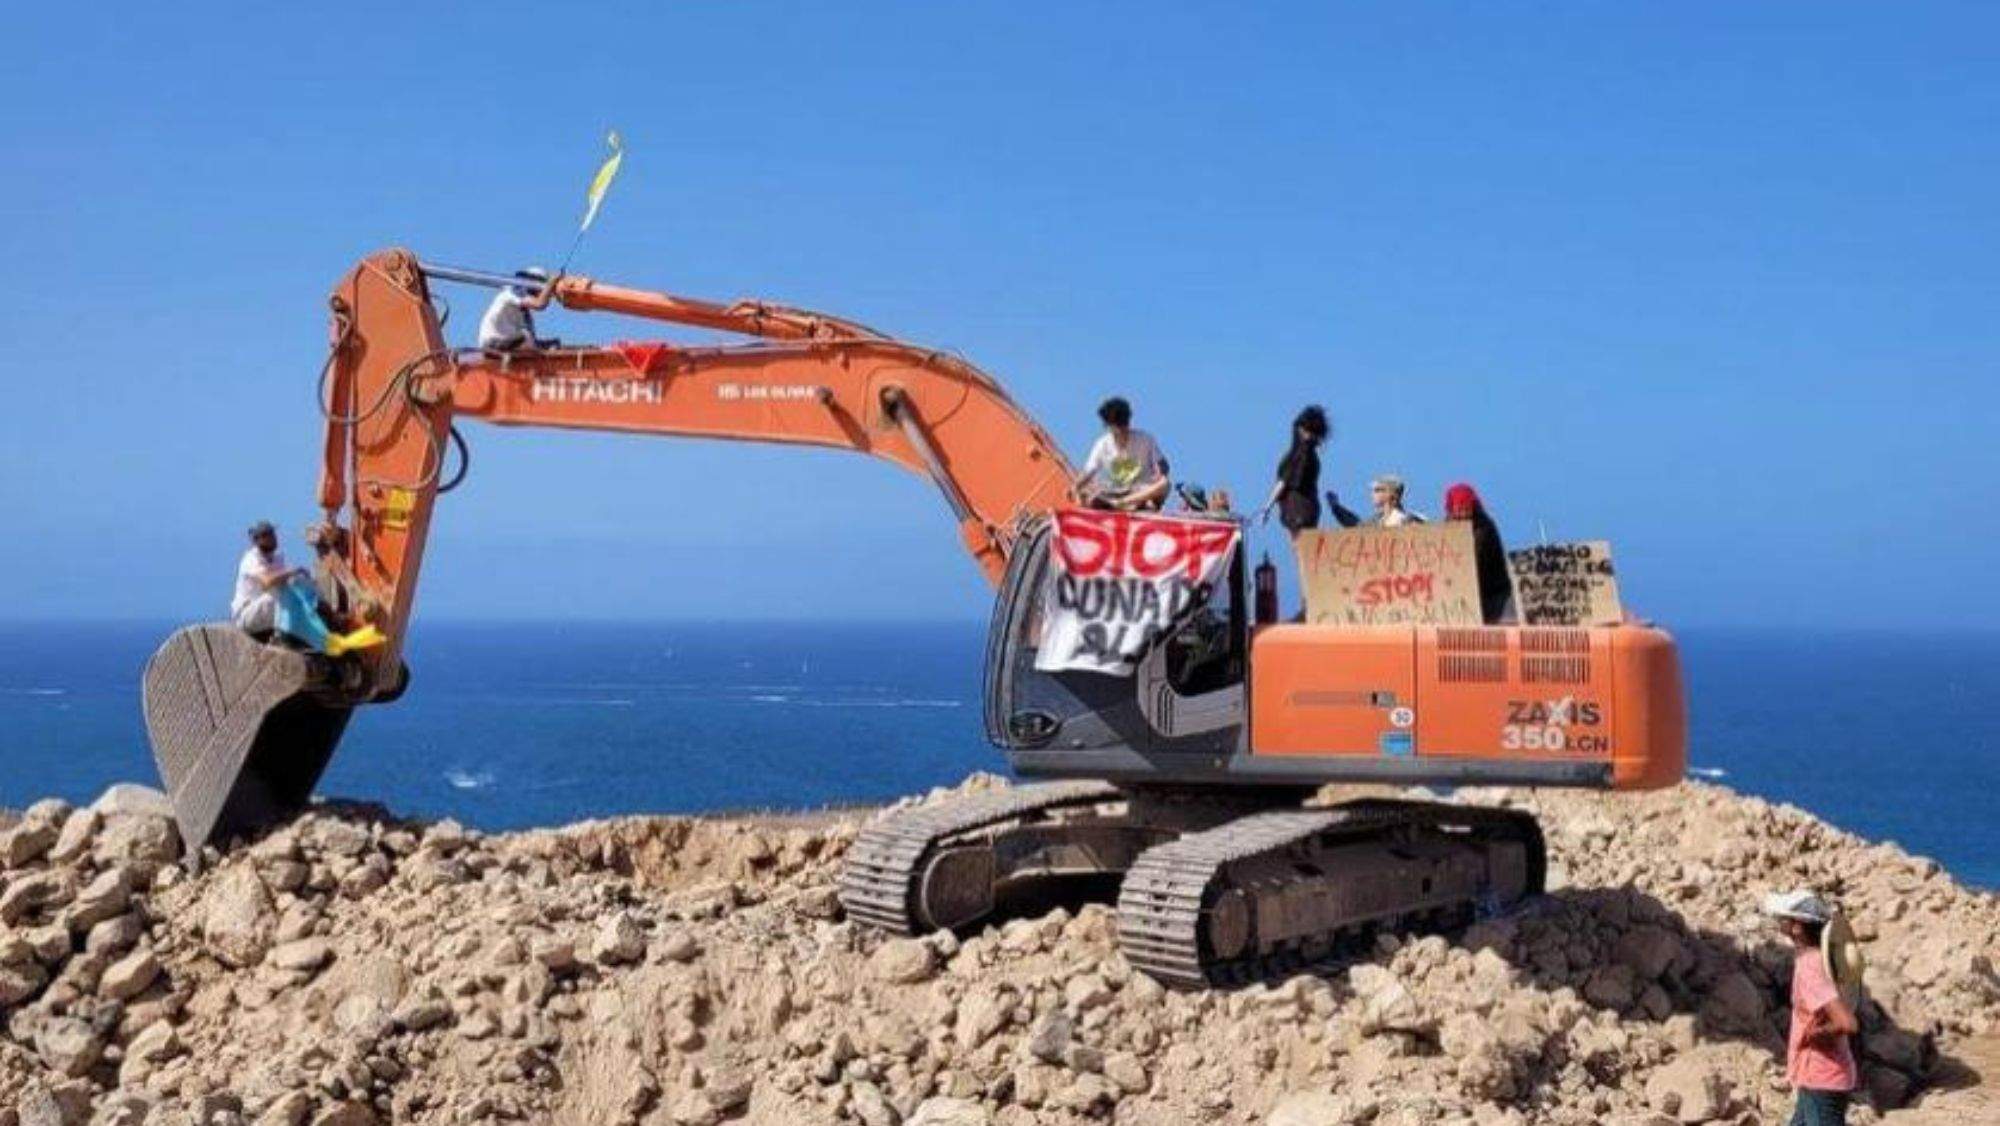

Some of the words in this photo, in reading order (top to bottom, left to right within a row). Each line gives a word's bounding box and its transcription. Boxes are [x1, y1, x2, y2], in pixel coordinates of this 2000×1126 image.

[532, 376, 662, 404] HITACHI
[1052, 508, 1234, 583] STOP
[1507, 694, 1601, 726] ZAXIS
[1501, 724, 1565, 751] 350
